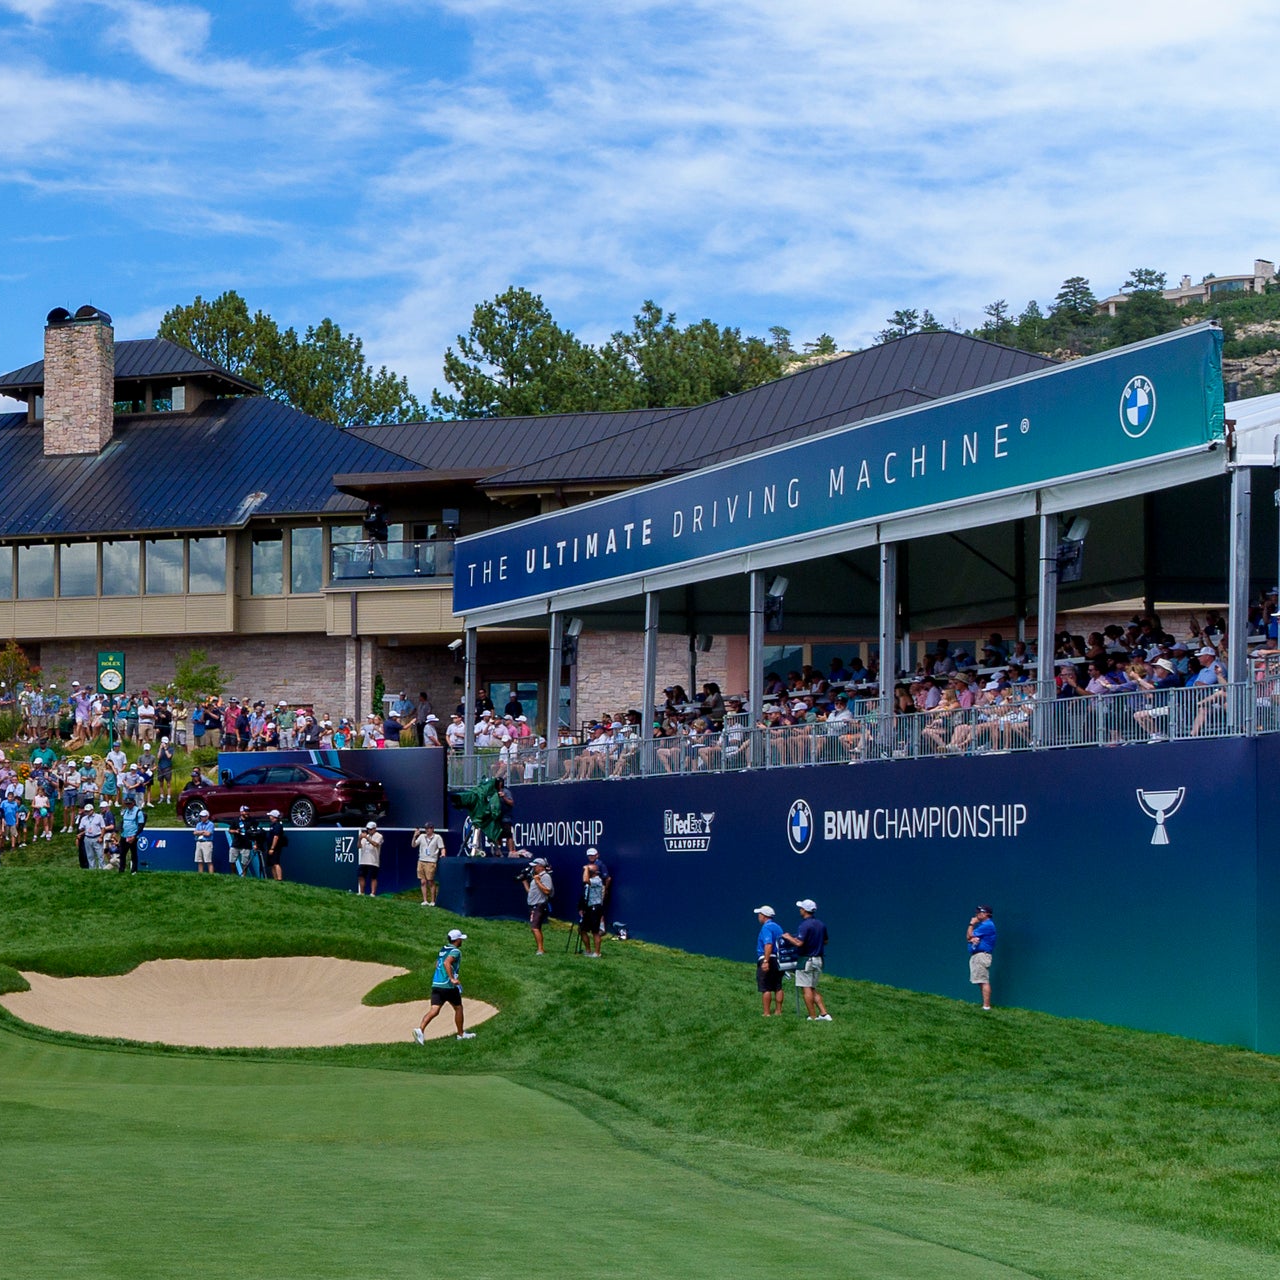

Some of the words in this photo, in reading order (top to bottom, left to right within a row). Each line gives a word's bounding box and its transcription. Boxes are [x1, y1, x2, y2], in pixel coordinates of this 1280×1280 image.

[468, 556, 508, 587] THE
[525, 518, 652, 574] ULTIMATE
[673, 478, 800, 538] DRIVING
[513, 820, 604, 847] CHAMPIONSHIP
[673, 812, 703, 835] FedEx
[824, 810, 870, 841] BMW
[873, 803, 1028, 839] CHAMPIONSHIP
[342, 836, 355, 853] i7
[669, 839, 706, 849] PLAYOFFS
[334, 853, 355, 863] M70
